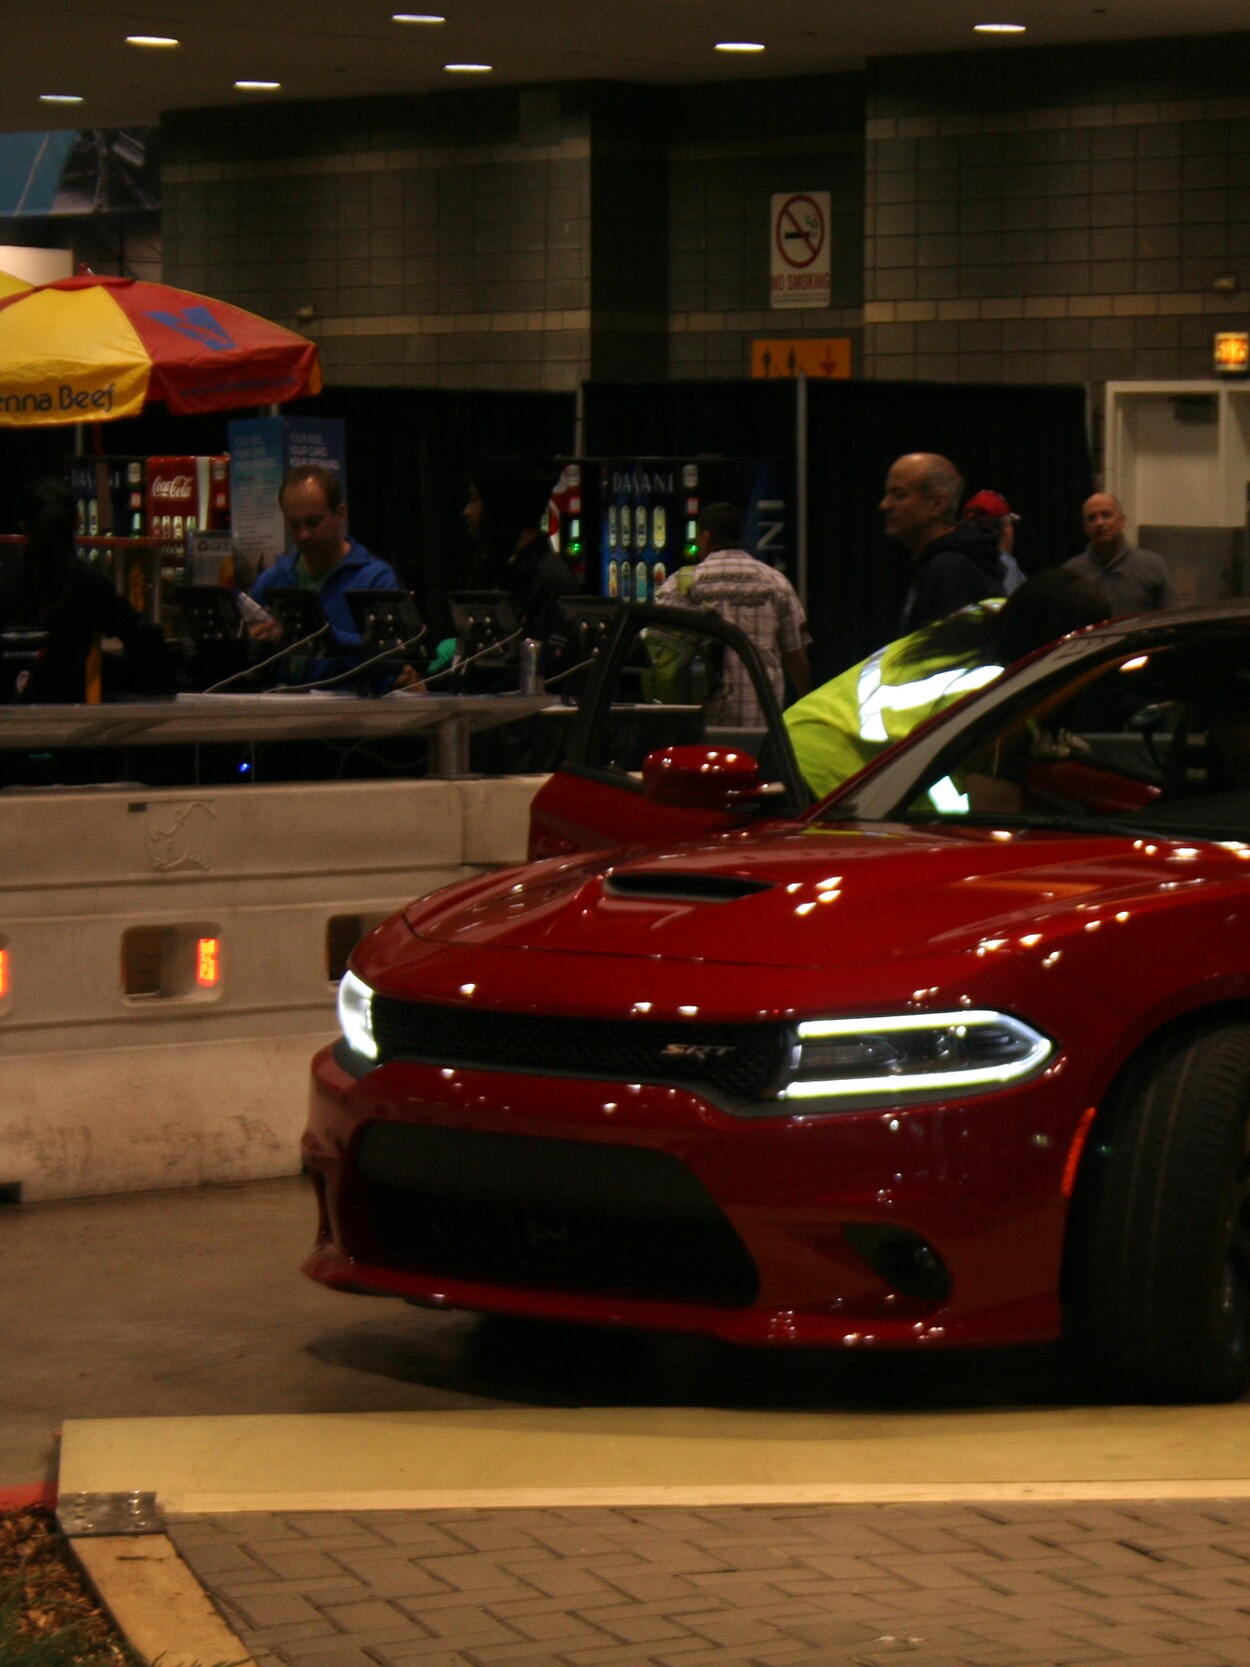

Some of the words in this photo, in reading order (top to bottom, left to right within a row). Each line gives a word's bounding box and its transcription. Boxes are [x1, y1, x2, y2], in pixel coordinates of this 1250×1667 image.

[772, 274, 785, 291] NO
[787, 272, 831, 291] SMOKING
[59, 383, 115, 412] Beef
[613, 467, 673, 495] DASANI
[660, 1043, 738, 1060] SRT
